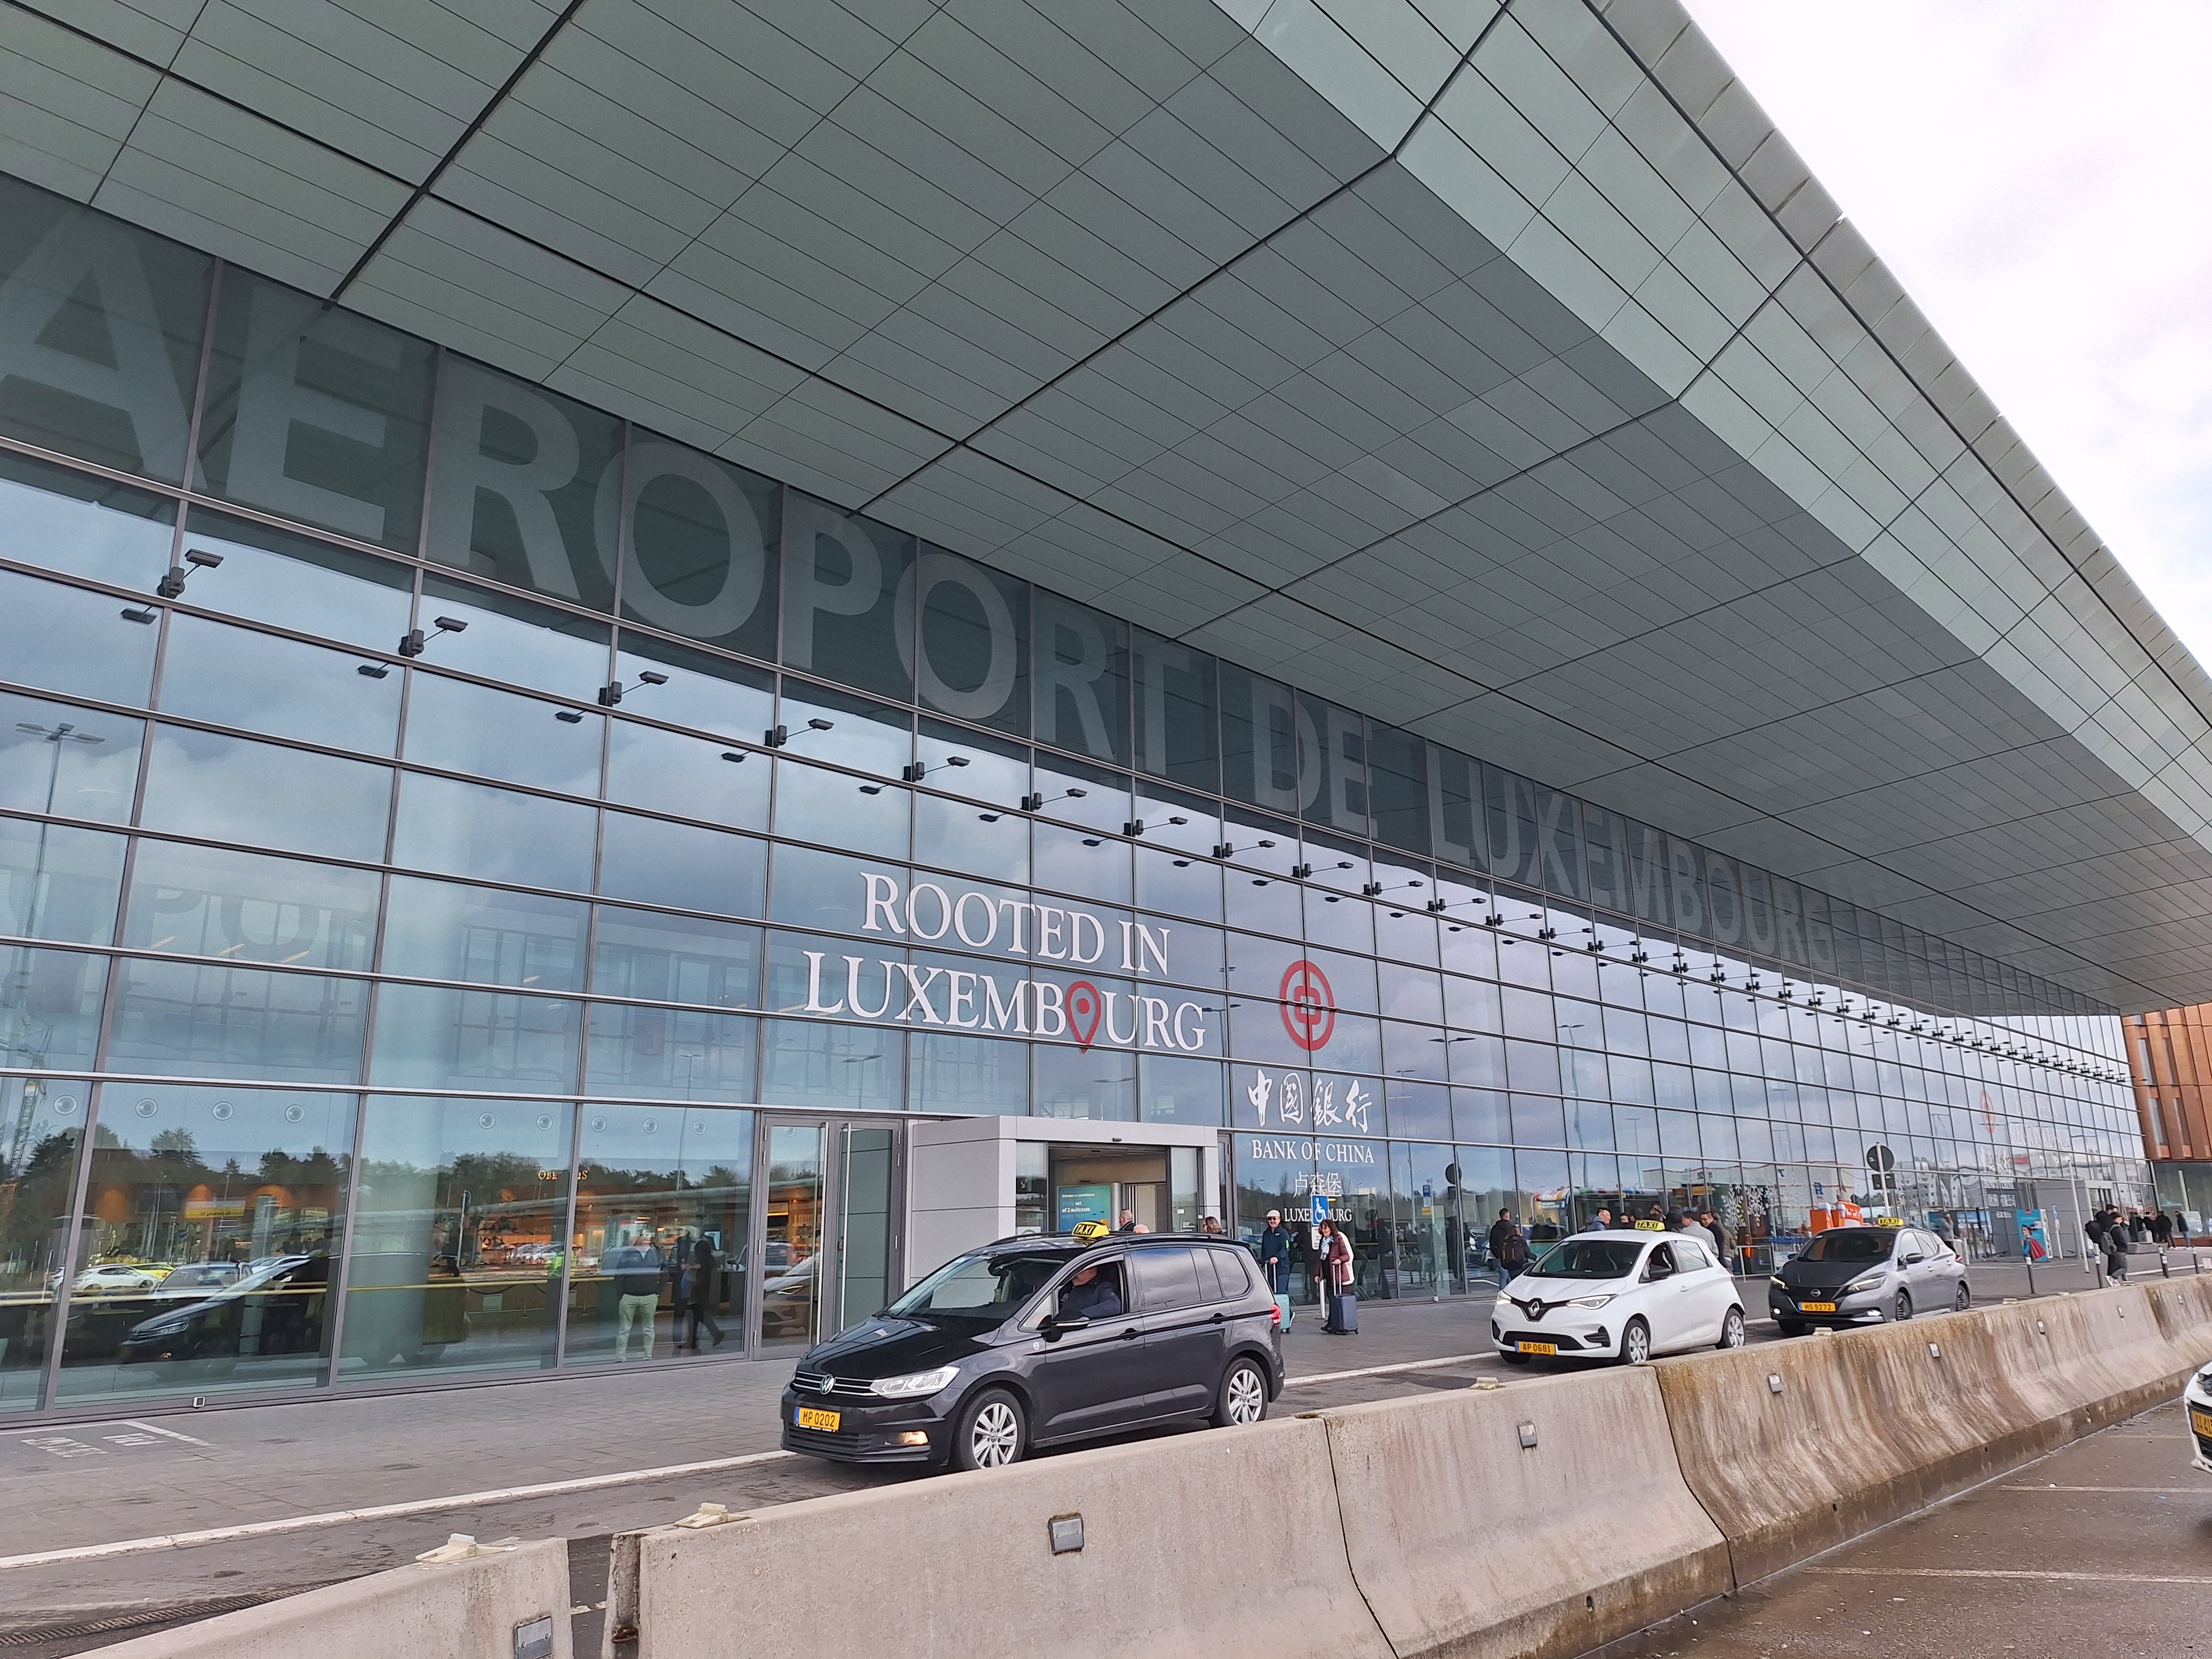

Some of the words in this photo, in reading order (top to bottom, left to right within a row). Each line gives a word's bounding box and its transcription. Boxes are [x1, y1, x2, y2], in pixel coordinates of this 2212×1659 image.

[0, 209, 1191, 776] AEROPORT
[1250, 675, 1378, 840] DE
[1426, 741, 1837, 969] LUXEMBOURG
[859, 871, 1105, 963] ROOTED
[1117, 919, 1171, 976] IN
[802, 950, 1206, 1053] LUXEMBOURG
[1252, 1139, 1297, 1160] BANK
[1301, 1141, 1321, 1161] OF
[1326, 1143, 1375, 1164] CHINA
[1284, 1207, 1353, 1223] LUXEOURG
[1075, 1224, 1094, 1234] TAXI
[1522, 1342, 1531, 1351] AP
[1532, 1343, 1551, 1353] 0681
[803, 1410, 813, 1424] MP
[814, 1412, 835, 1427] 0202
